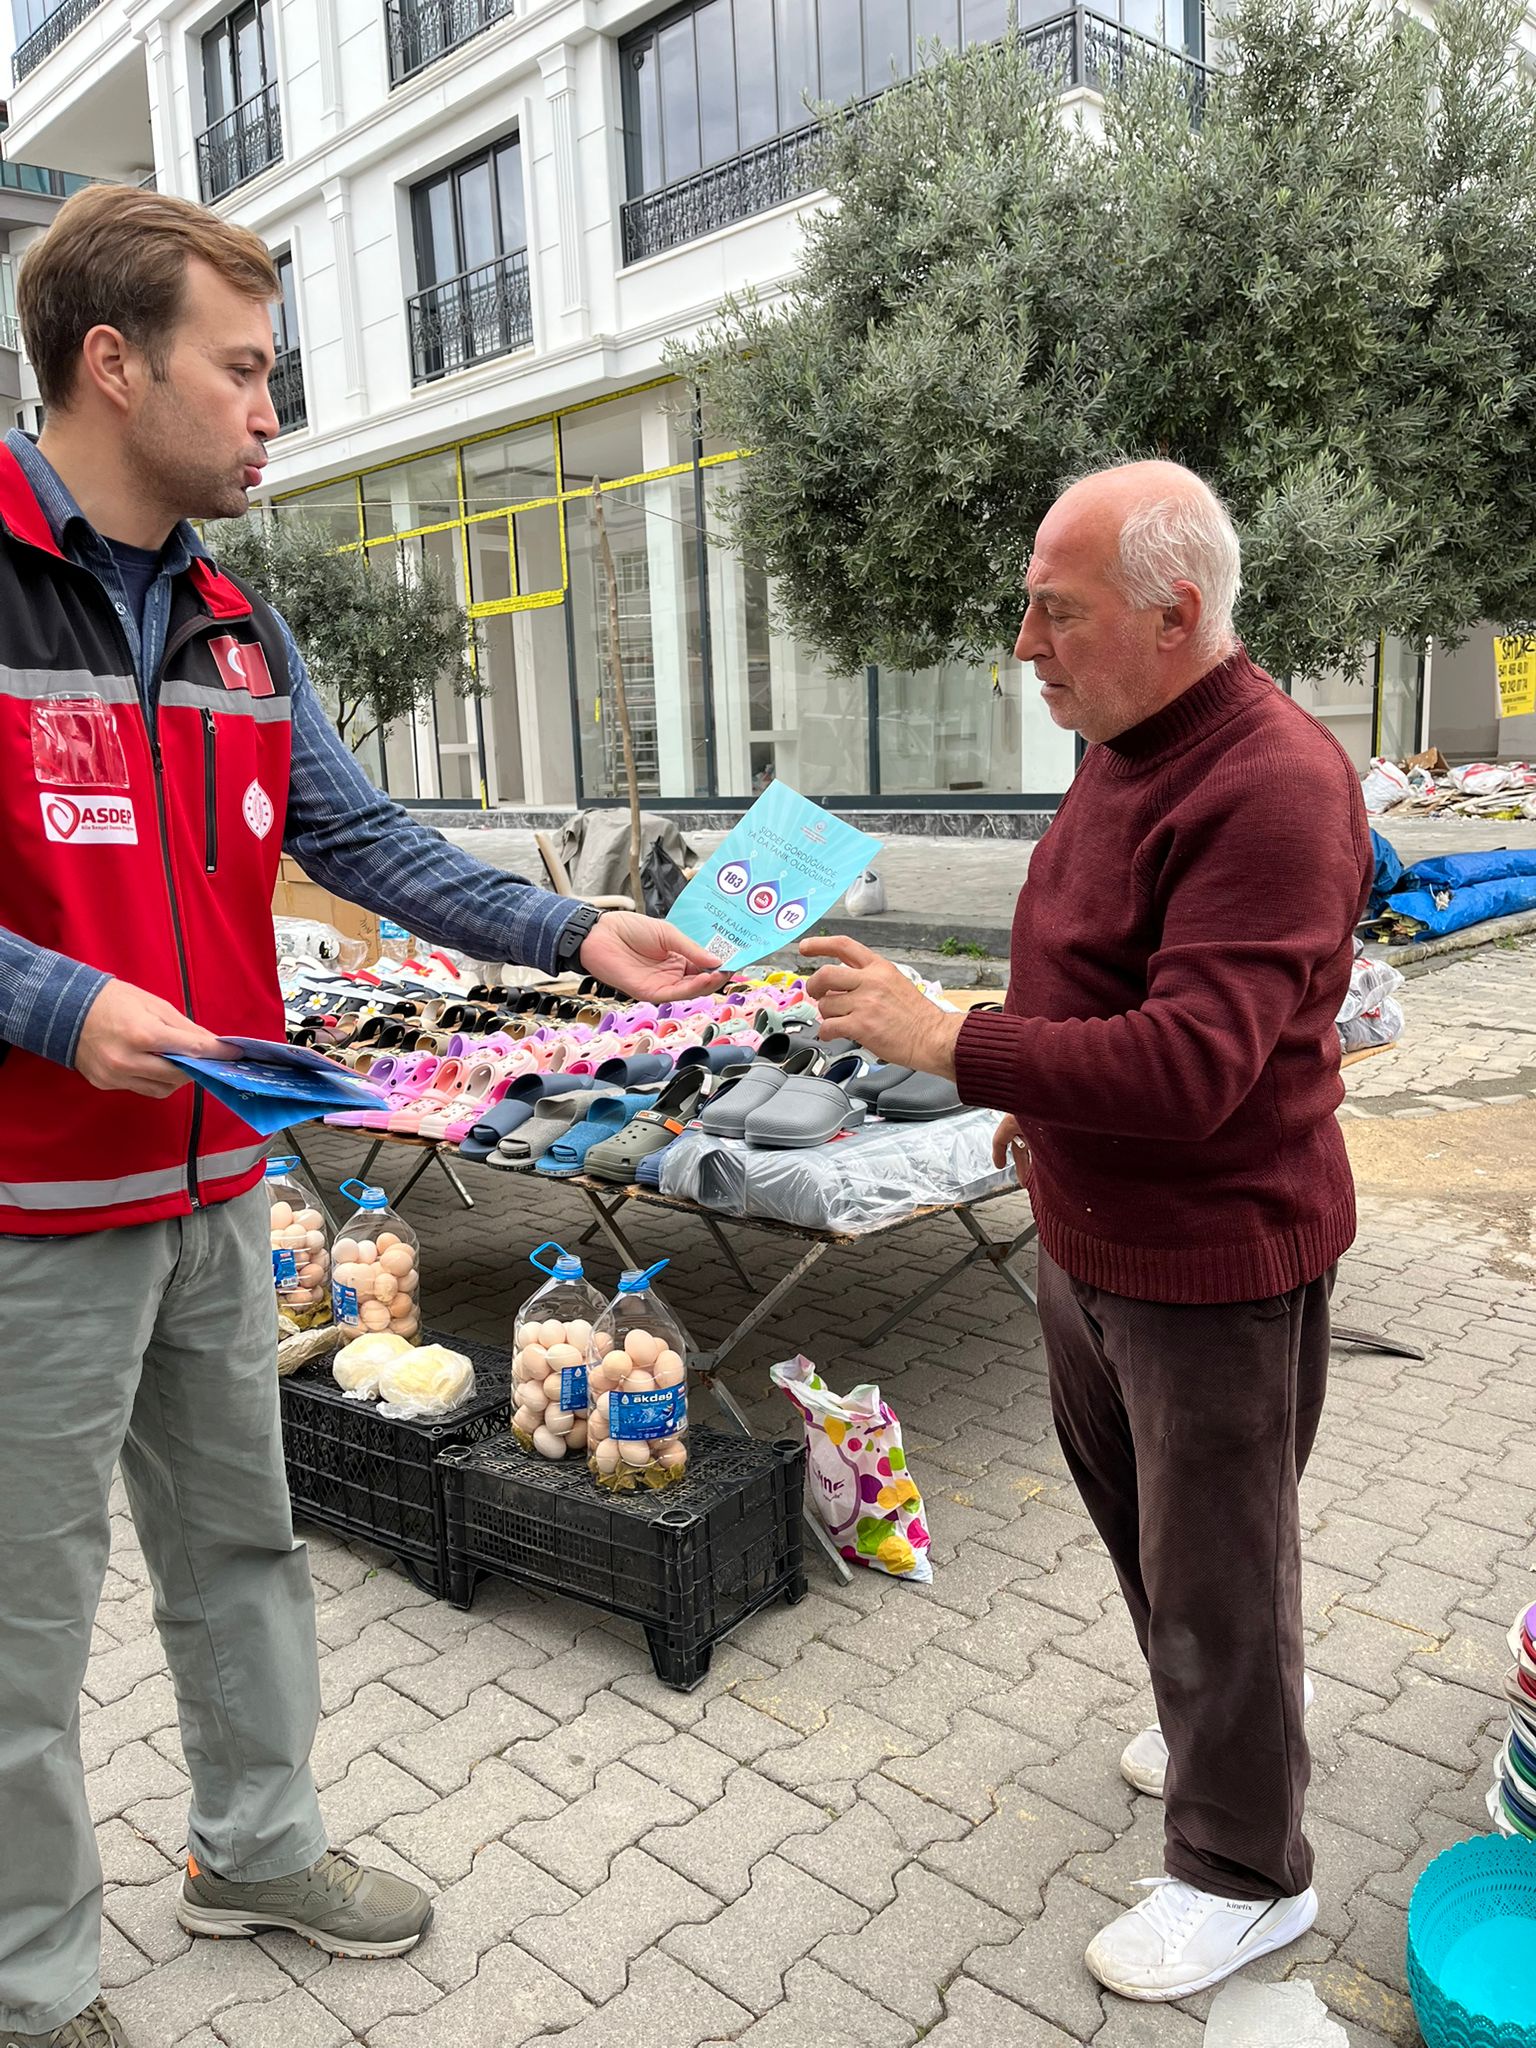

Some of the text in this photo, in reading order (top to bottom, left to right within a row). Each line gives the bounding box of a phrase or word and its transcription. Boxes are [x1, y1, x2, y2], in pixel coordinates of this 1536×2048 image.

[81, 808, 131, 824] ASDEP
[757, 837, 769, 848] DA
[724, 871, 743, 888] 183
[782, 910, 800, 924] 112
[610, 1392, 619, 1432] SAMSUN
[1226, 1901, 1252, 1911] kinetix
